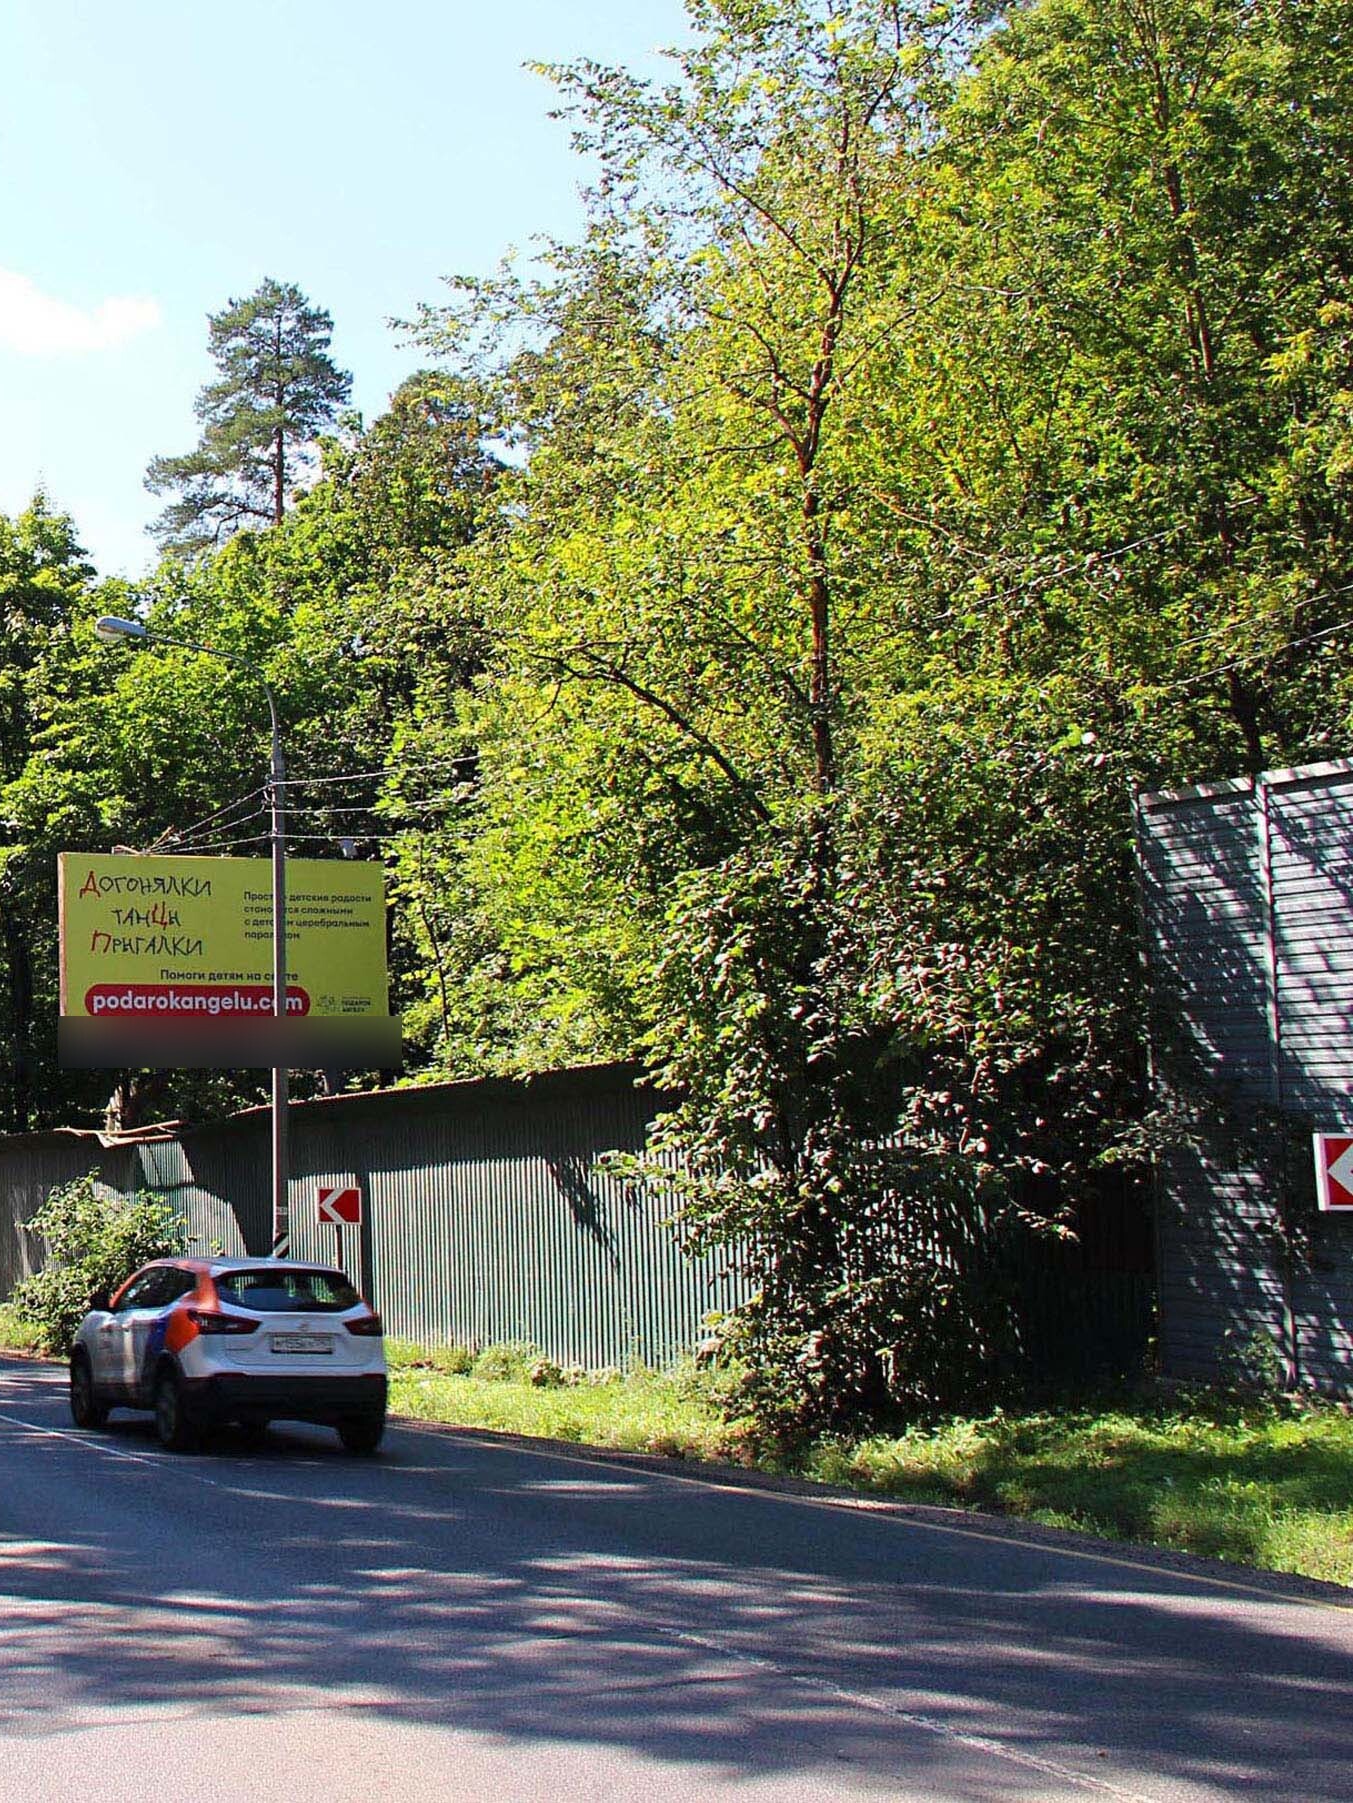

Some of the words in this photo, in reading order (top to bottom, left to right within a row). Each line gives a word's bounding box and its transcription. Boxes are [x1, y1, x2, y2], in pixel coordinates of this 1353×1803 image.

[244, 891, 287, 901] Прост
[331, 894, 371, 903] радости
[244, 906, 299, 914] станотся
[252, 919, 293, 927] детсм
[244, 932, 300, 940] паралом
[160, 970, 205, 980] Помоги
[208, 971, 243, 981] детям
[264, 973, 298, 981] сте
[93, 991, 303, 1014] podarokangelu.cm
